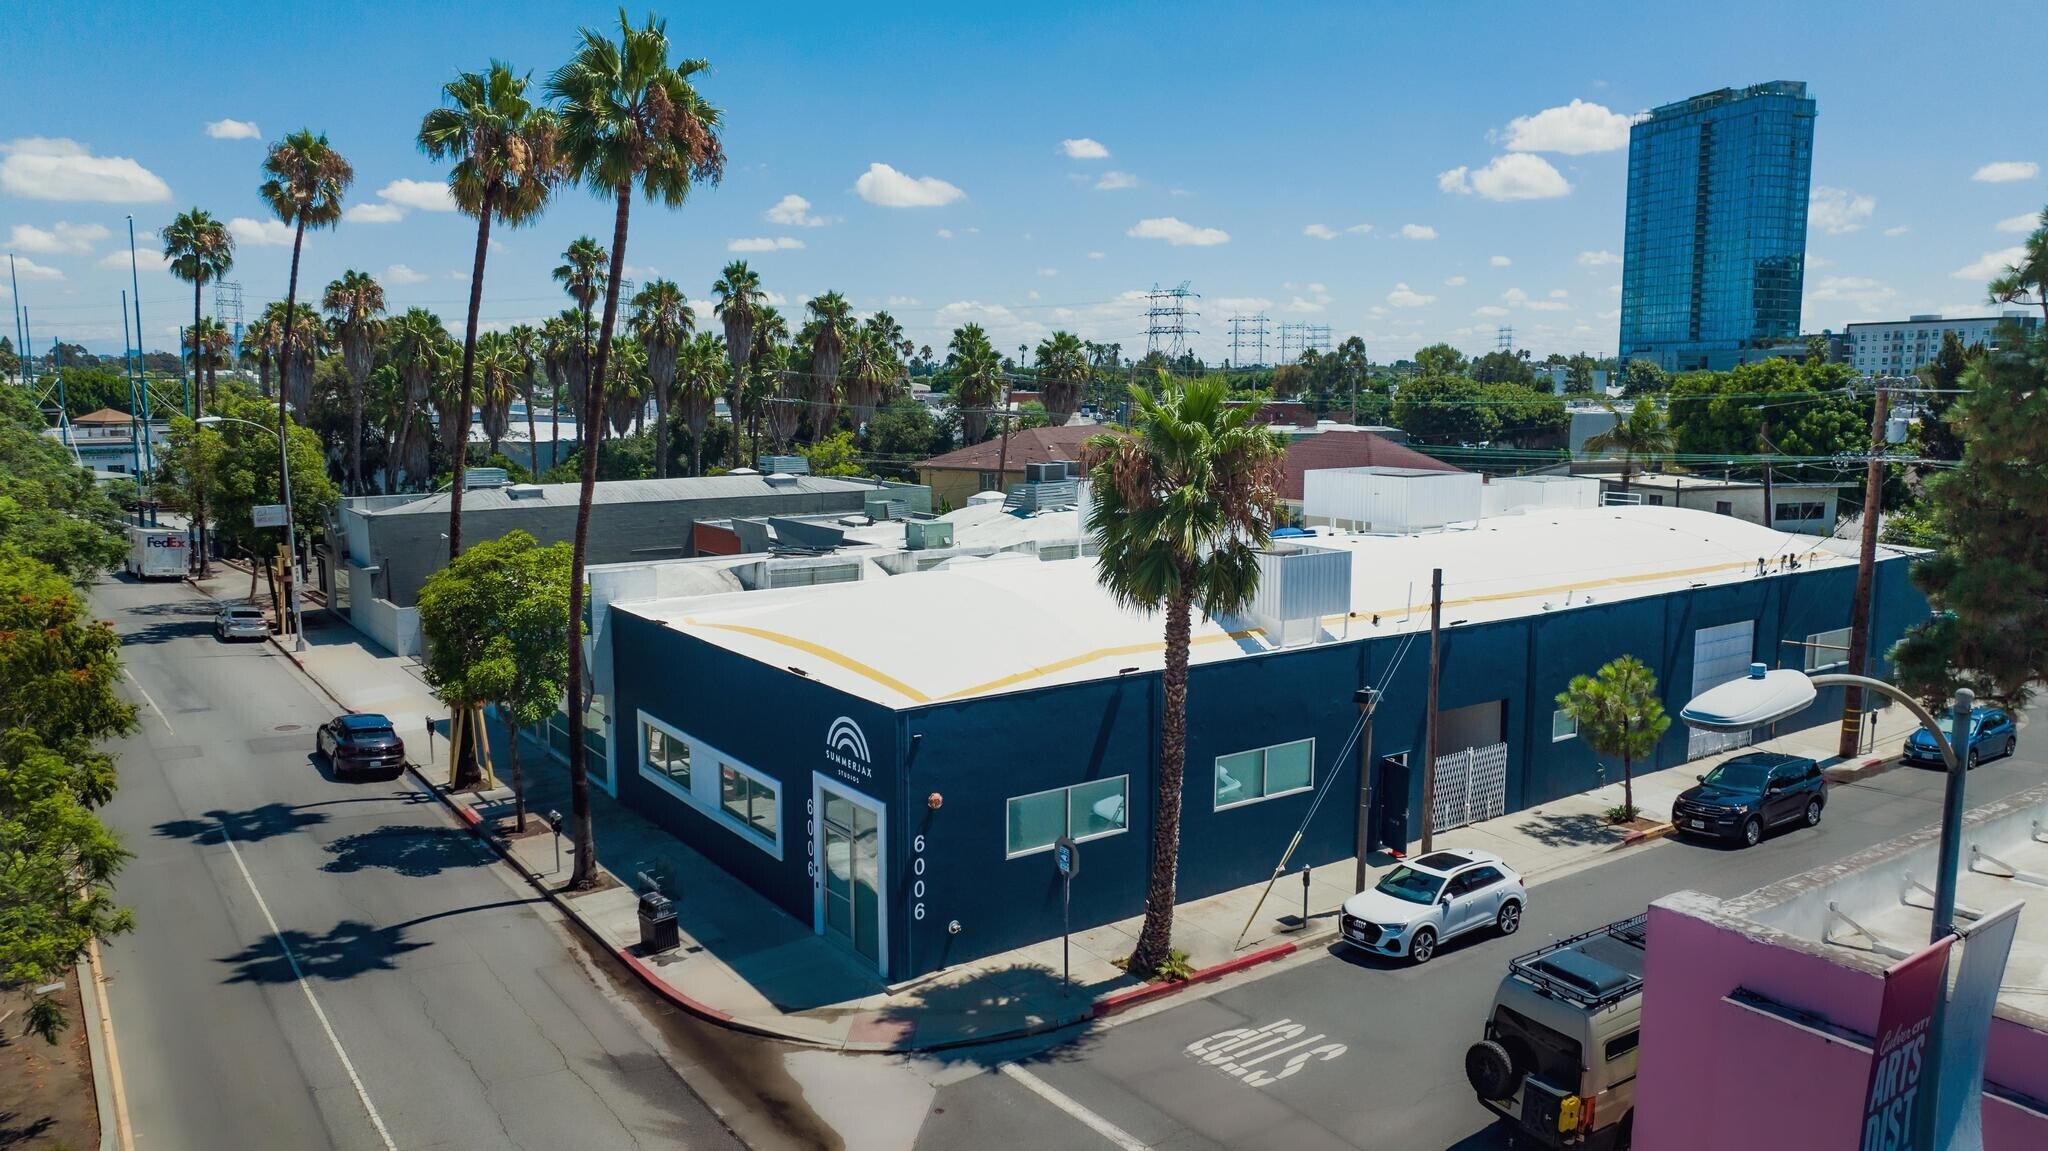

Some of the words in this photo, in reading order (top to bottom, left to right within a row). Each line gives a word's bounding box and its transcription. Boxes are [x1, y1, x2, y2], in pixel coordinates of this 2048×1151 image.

[147, 536, 185, 548] FedEx
[826, 749, 872, 778] SUMMERJAX
[838, 769, 859, 784] STUDIOS
[914, 834, 925, 920] 6006
[1869, 1033, 1925, 1112] ARTS
[1863, 1086, 1917, 1151] DIST
